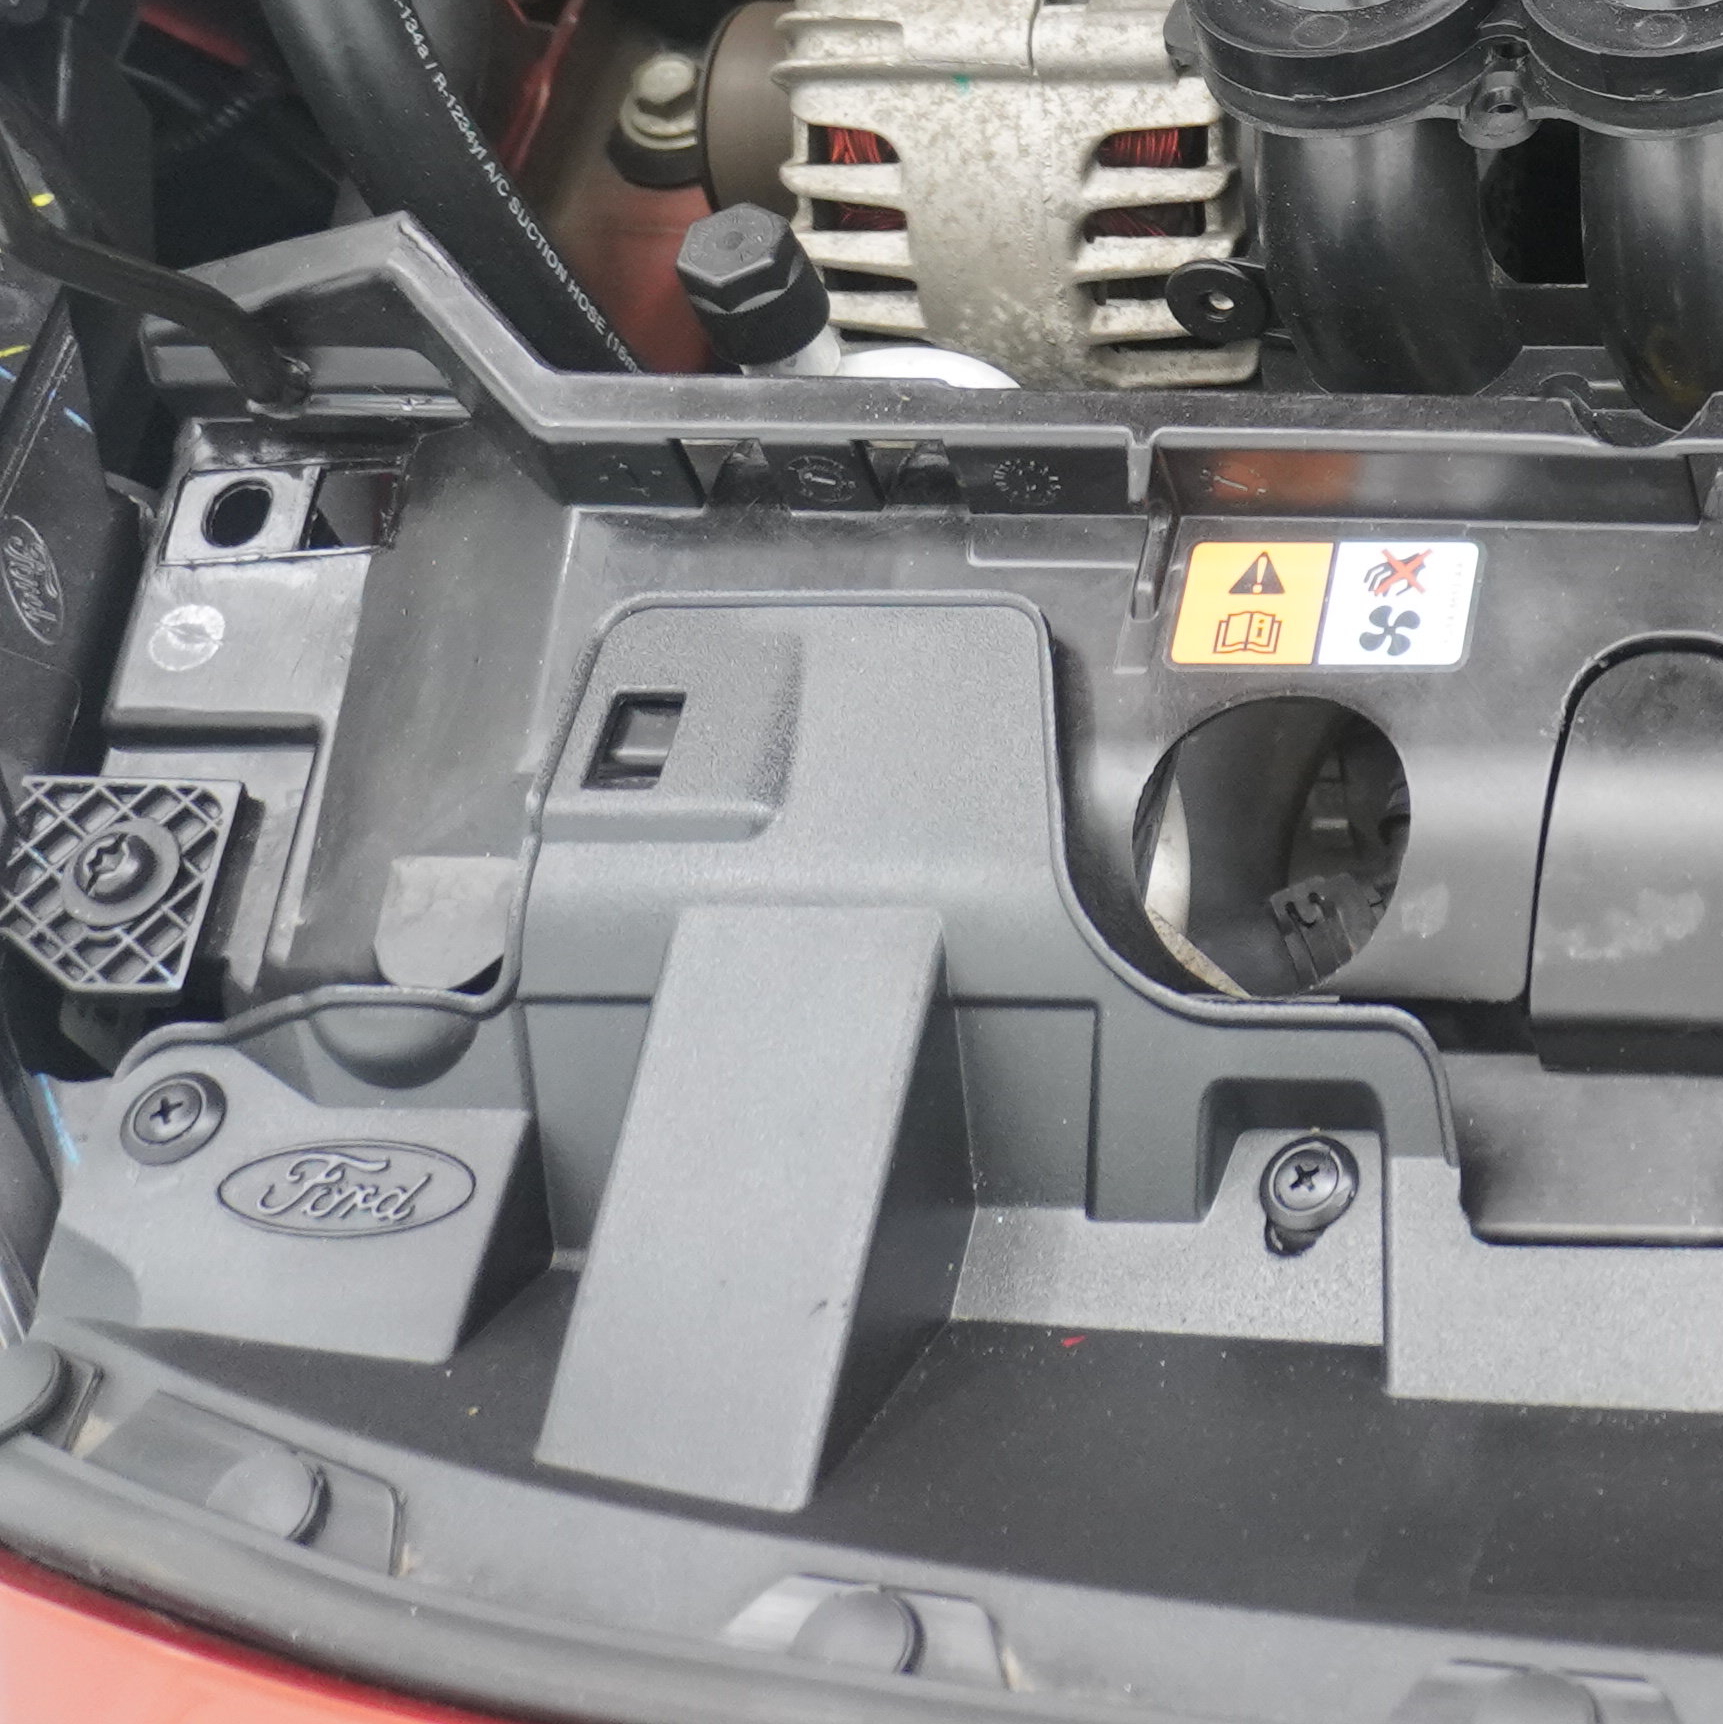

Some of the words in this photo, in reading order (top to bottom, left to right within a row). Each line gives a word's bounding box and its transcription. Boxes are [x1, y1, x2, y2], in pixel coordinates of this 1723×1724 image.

[483, 160, 510, 198] A/C
[508, 196, 569, 284] SUCTION
[567, 278, 607, 336] HOSE
[250, 1148, 437, 1227] Ford
